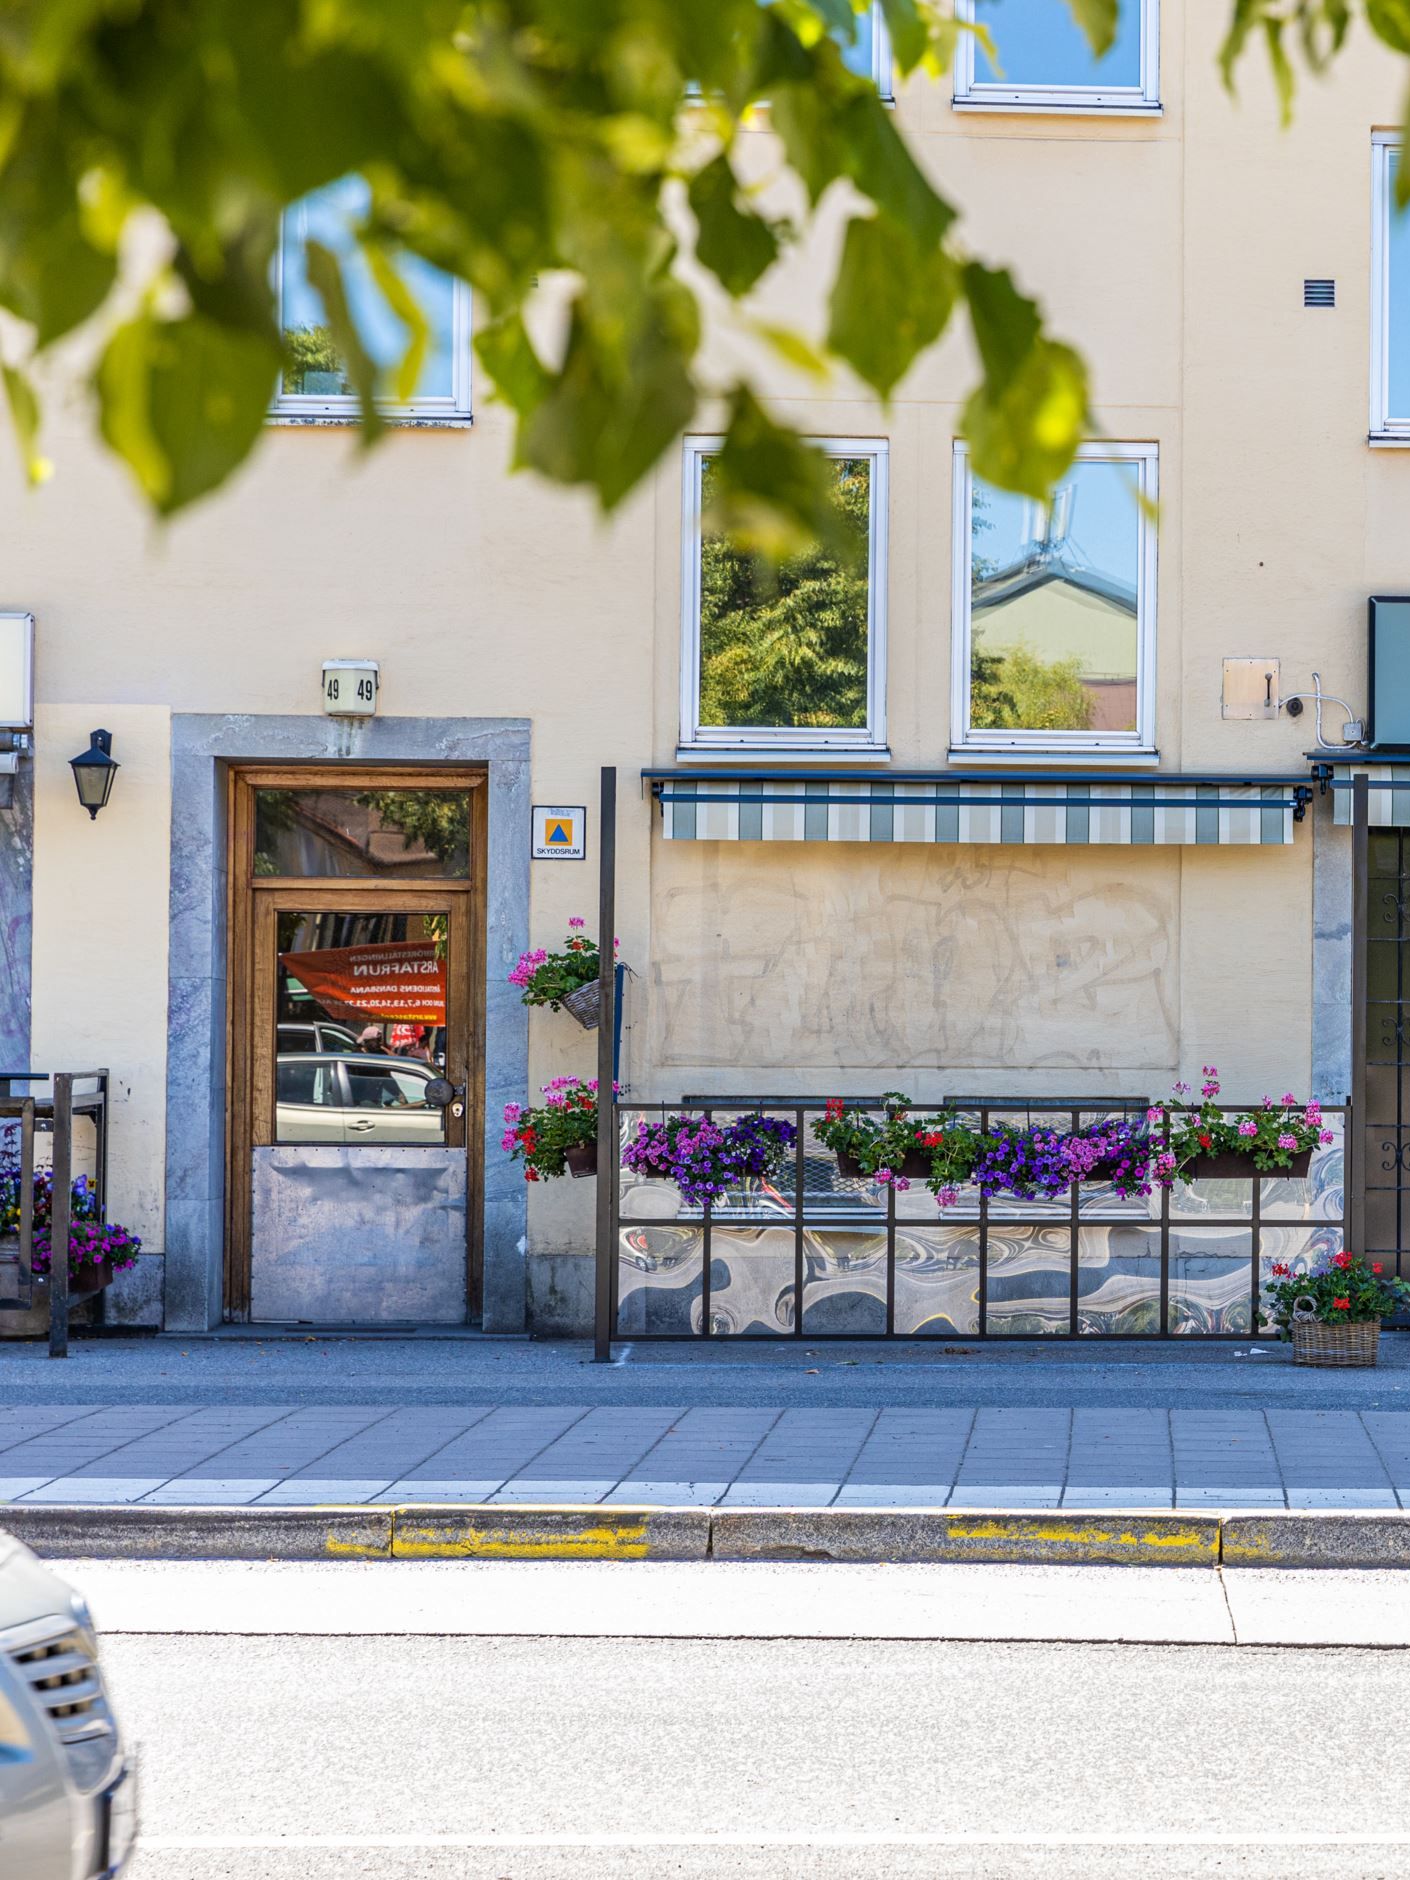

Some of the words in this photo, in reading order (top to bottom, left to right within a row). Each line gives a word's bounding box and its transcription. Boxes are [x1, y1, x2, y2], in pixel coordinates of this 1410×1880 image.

[327, 678, 339, 701] 49
[357, 678, 373, 701] 49
[536, 847, 581, 855] SKYDDSRUM
